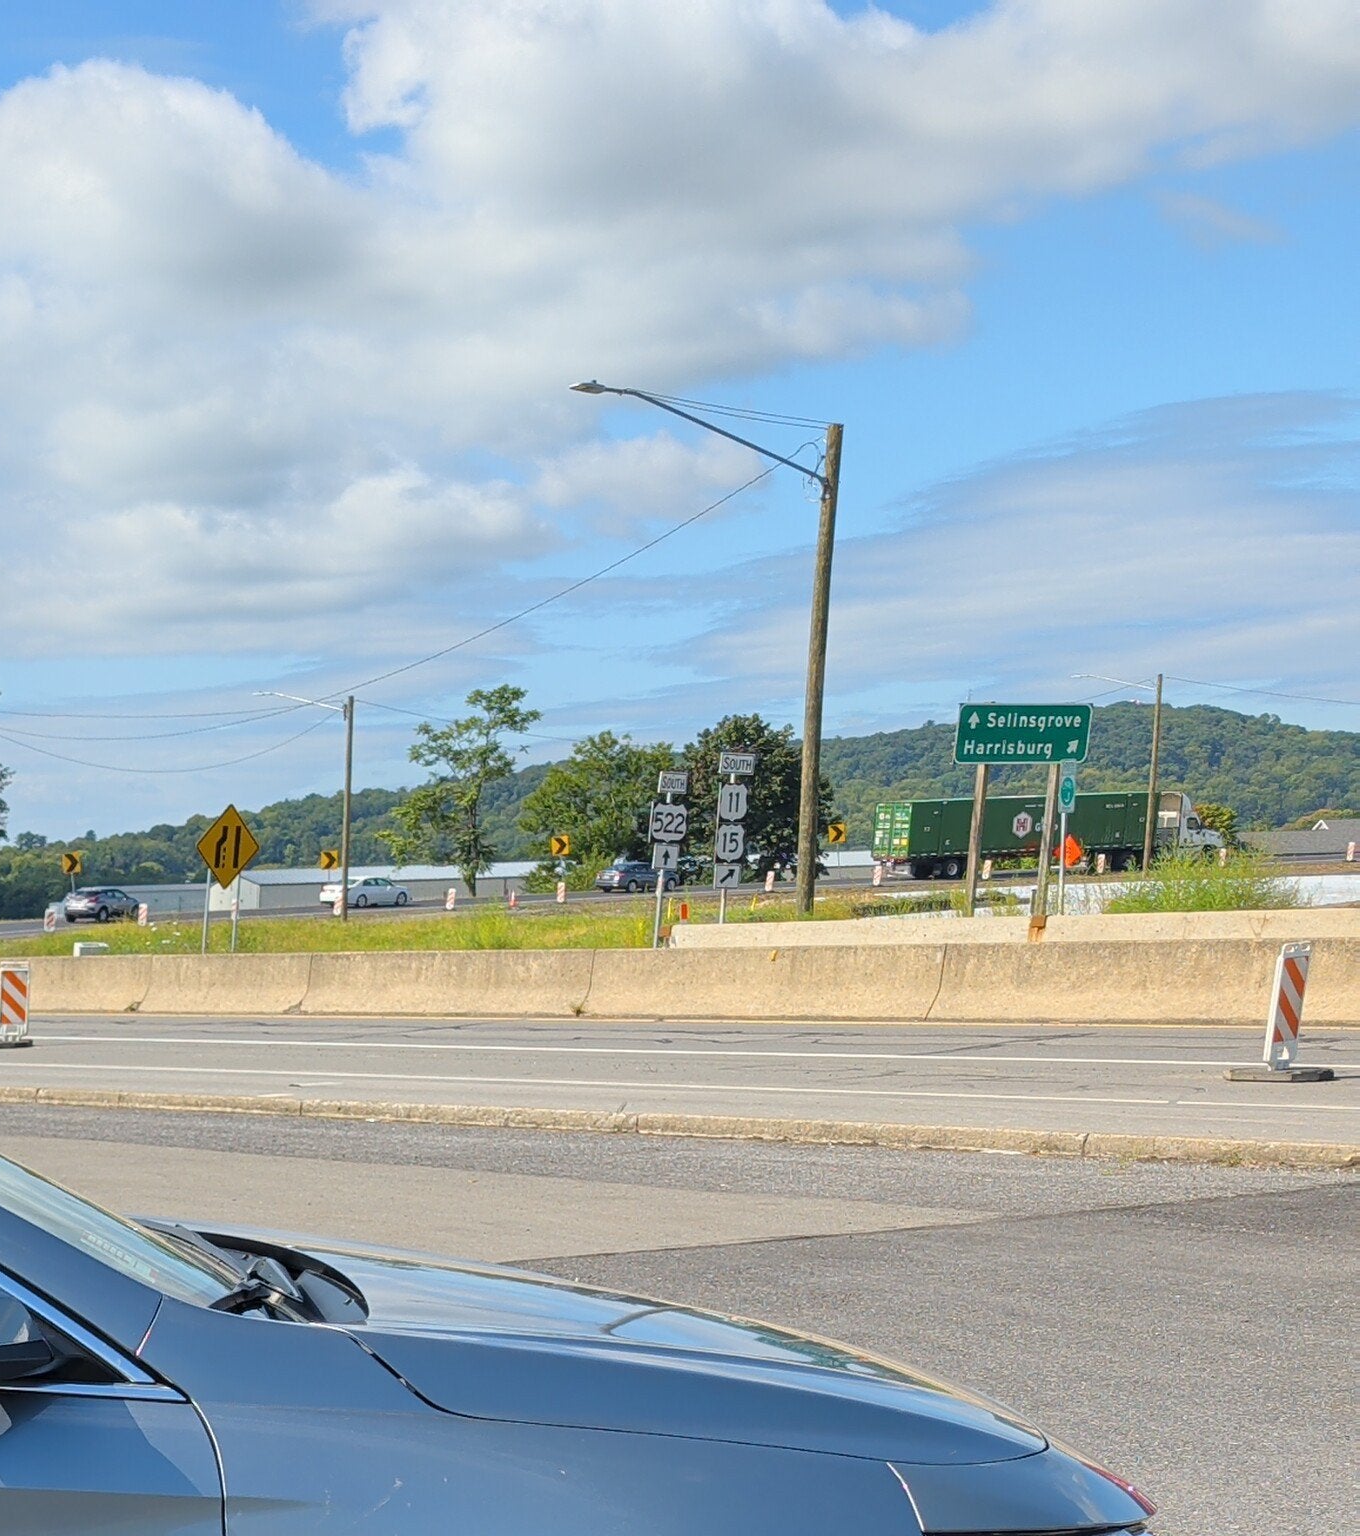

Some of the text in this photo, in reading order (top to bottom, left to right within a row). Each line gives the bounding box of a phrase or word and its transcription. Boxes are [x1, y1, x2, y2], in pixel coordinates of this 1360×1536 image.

[986, 712, 1081, 732] Selinsgrove
[963, 740, 1052, 759] Harrisburg
[723, 756, 752, 771] SOUTH
[661, 775, 685, 790] SOUTH
[728, 792, 740, 813] 11
[653, 811, 685, 834] 522
[722, 832, 739, 853] 15
